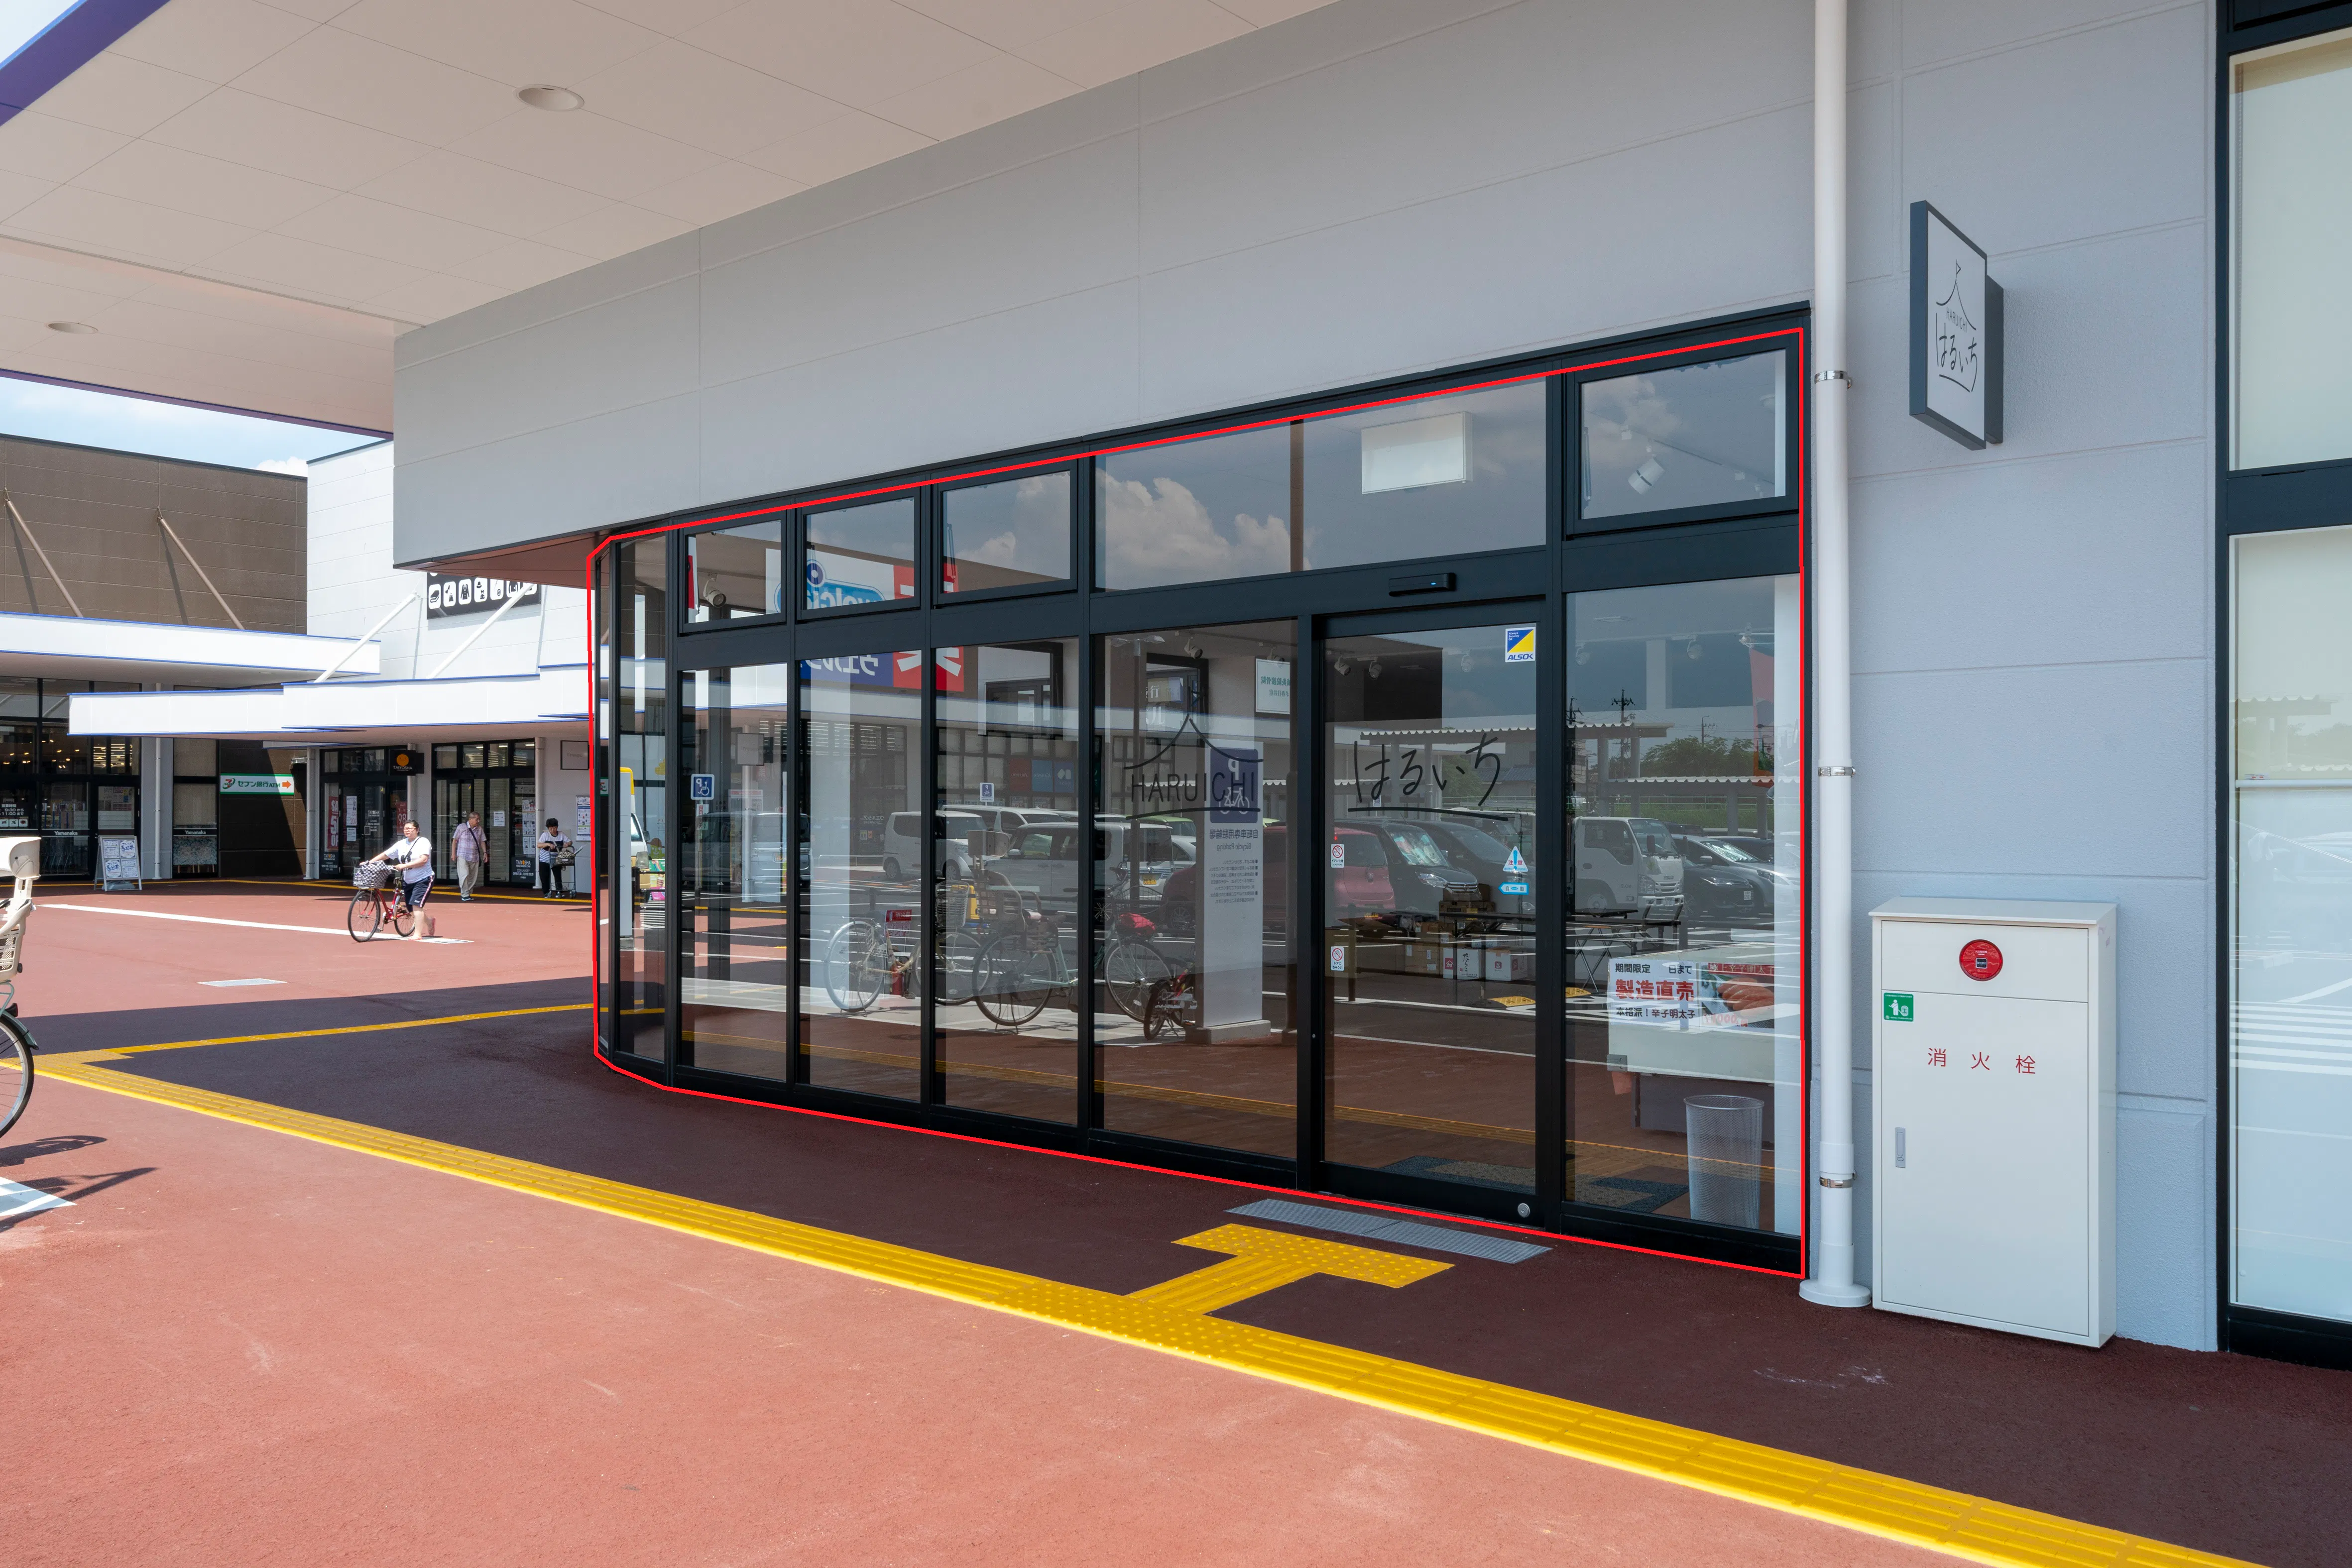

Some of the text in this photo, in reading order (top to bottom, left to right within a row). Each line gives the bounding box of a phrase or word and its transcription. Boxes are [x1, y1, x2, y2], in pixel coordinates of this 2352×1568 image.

[1946, 307, 1967, 333] HARUICHI
[1936, 313, 1977, 392] はるいち
[1353, 733, 1501, 807] はるいち
[1131, 772, 1254, 802] HARUICHI
[1615, 963, 1651, 973] 期間限定
[1615, 979, 1694, 1002] 製造直売
[1927, 1047, 2036, 1075] 消火栓
